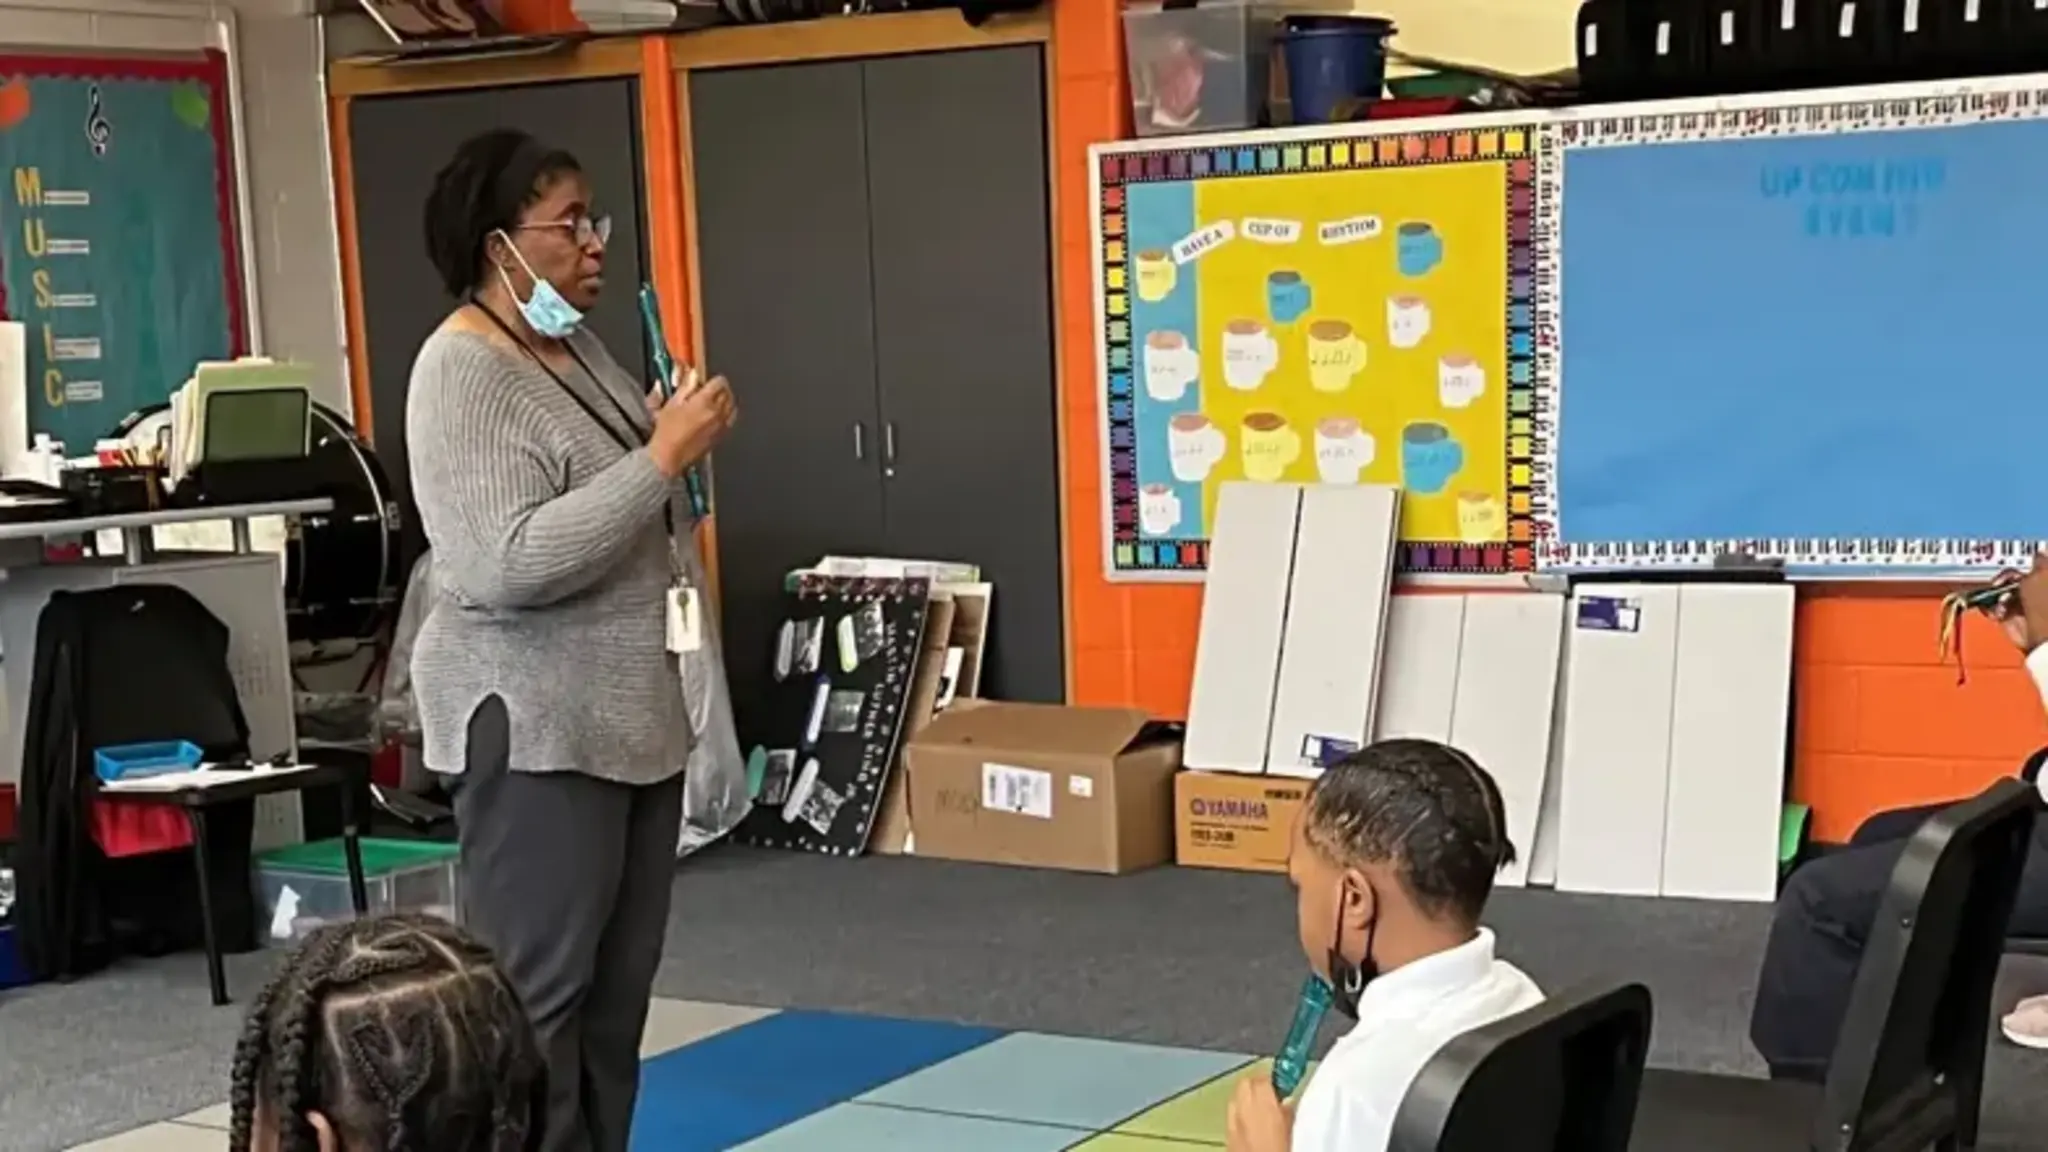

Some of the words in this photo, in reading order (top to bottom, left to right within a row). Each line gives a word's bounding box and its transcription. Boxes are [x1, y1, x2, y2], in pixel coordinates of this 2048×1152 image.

[1181, 234, 1212, 257] HAVE
[1248, 222, 1272, 237] CUP
[1274, 224, 1291, 237] OF
[15, 166, 64, 407] MUSIC
[1208, 800, 1268, 819] YAMAHA
